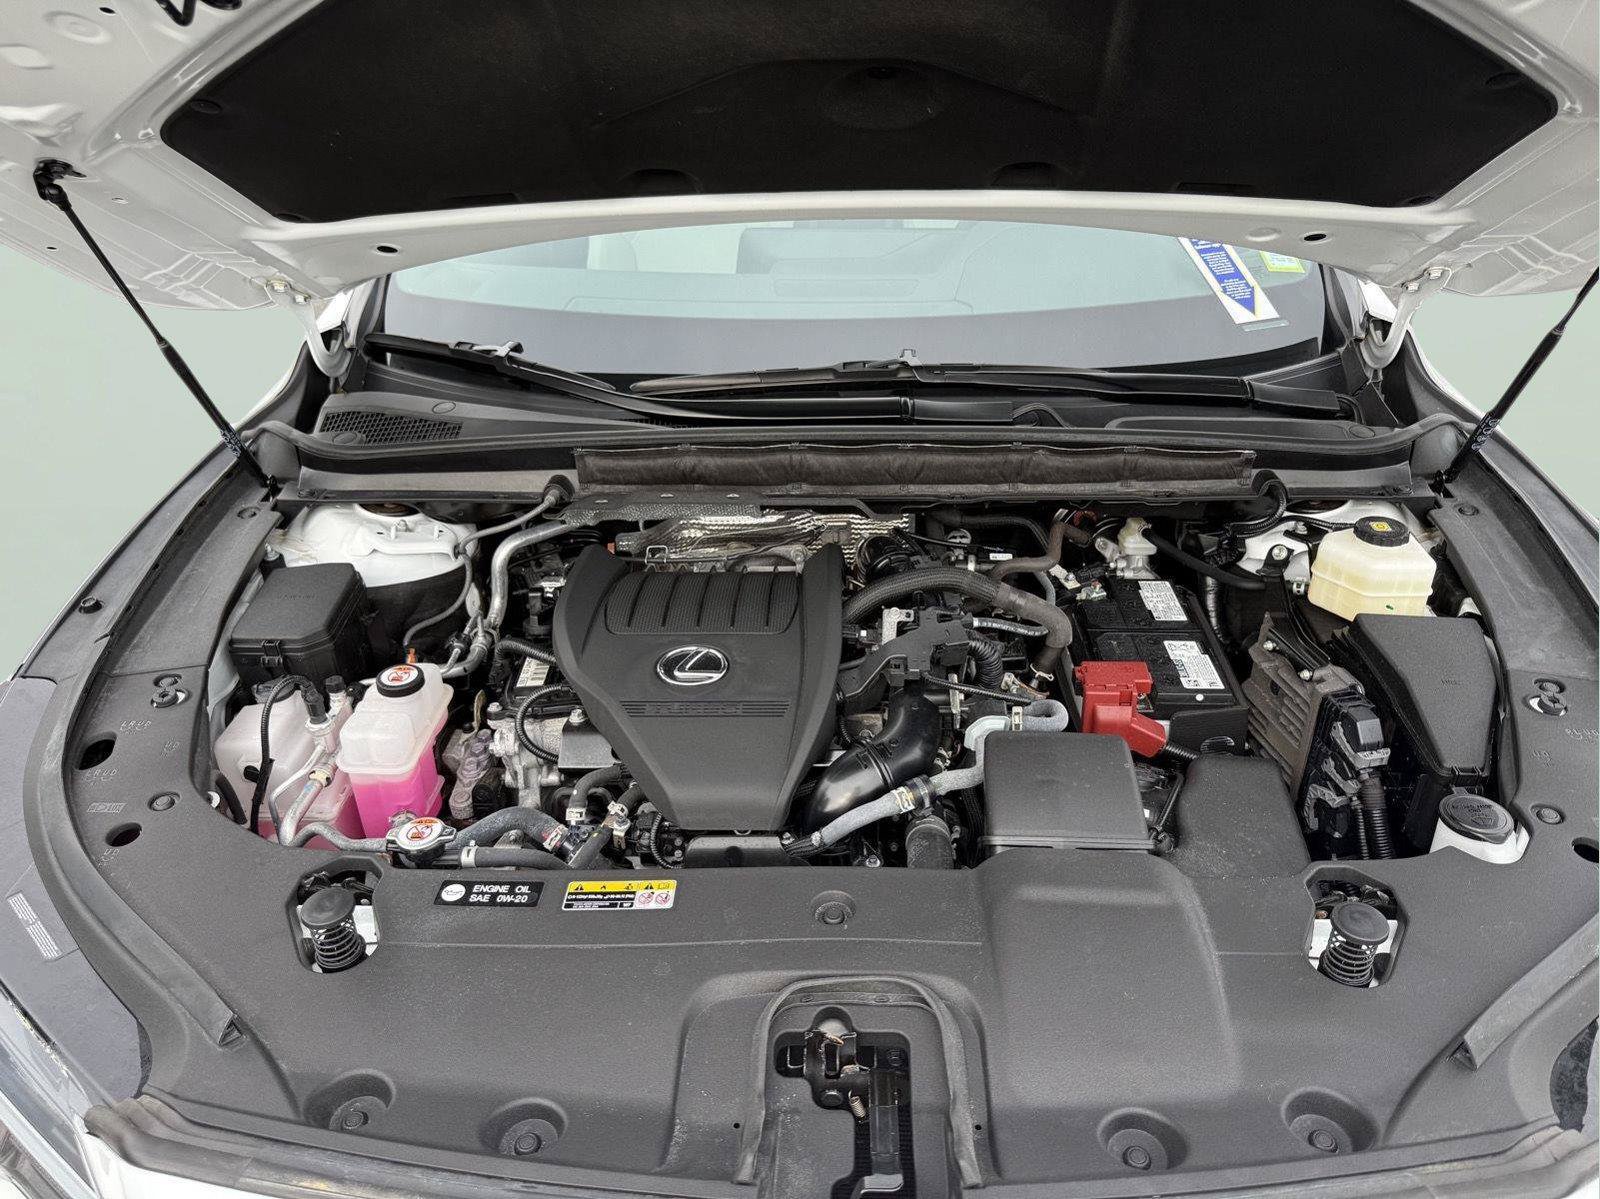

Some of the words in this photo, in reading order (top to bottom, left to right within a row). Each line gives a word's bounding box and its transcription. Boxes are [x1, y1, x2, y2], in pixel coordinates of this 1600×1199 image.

[472, 884, 511, 893] ENGINE
[515, 885, 532, 894] OIL
[469, 894, 491, 902] SAE
[496, 894, 529, 903] 0W-20
